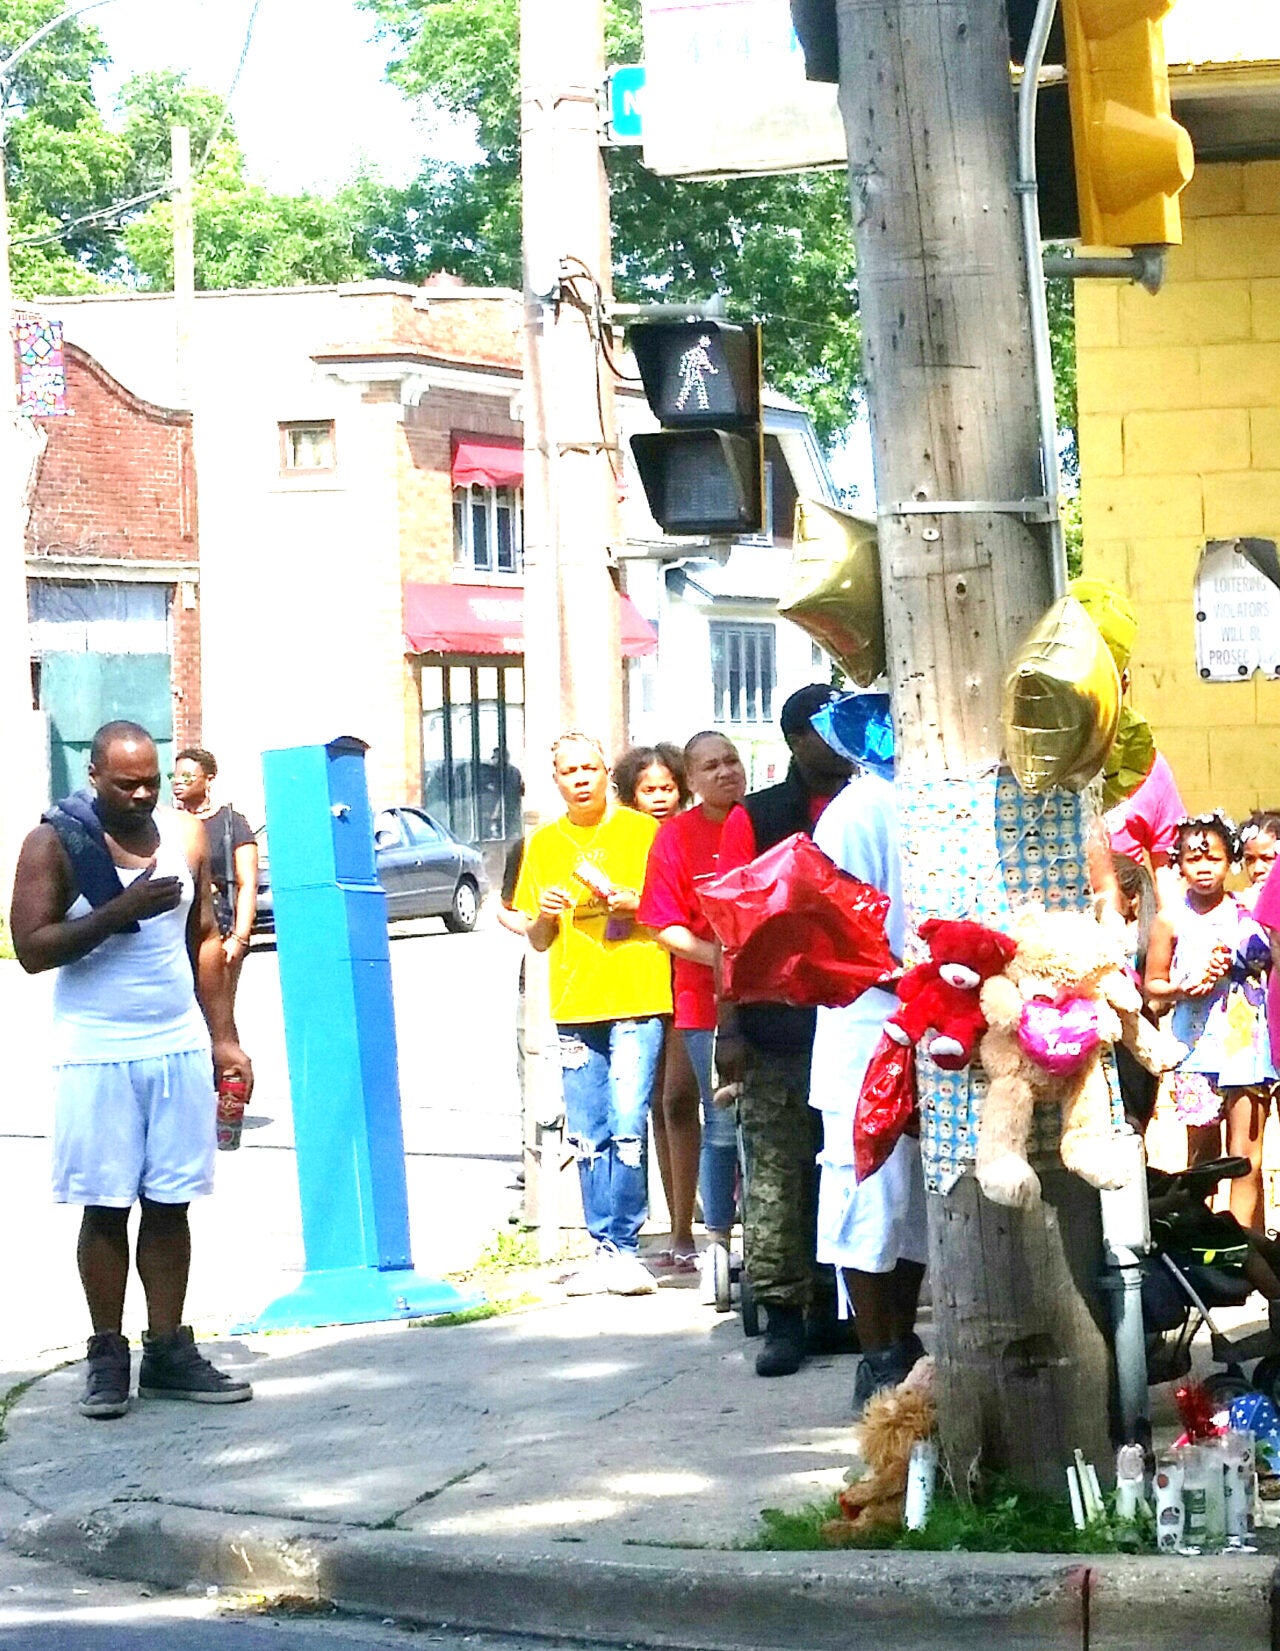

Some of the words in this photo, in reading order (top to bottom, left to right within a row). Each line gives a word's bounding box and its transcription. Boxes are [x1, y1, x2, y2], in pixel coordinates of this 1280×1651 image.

[1231, 553, 1248, 570] NO
[1213, 576, 1268, 593] LOITERING
[1220, 626, 1246, 642] WILL
[1208, 648, 1278, 666] PROSEC
